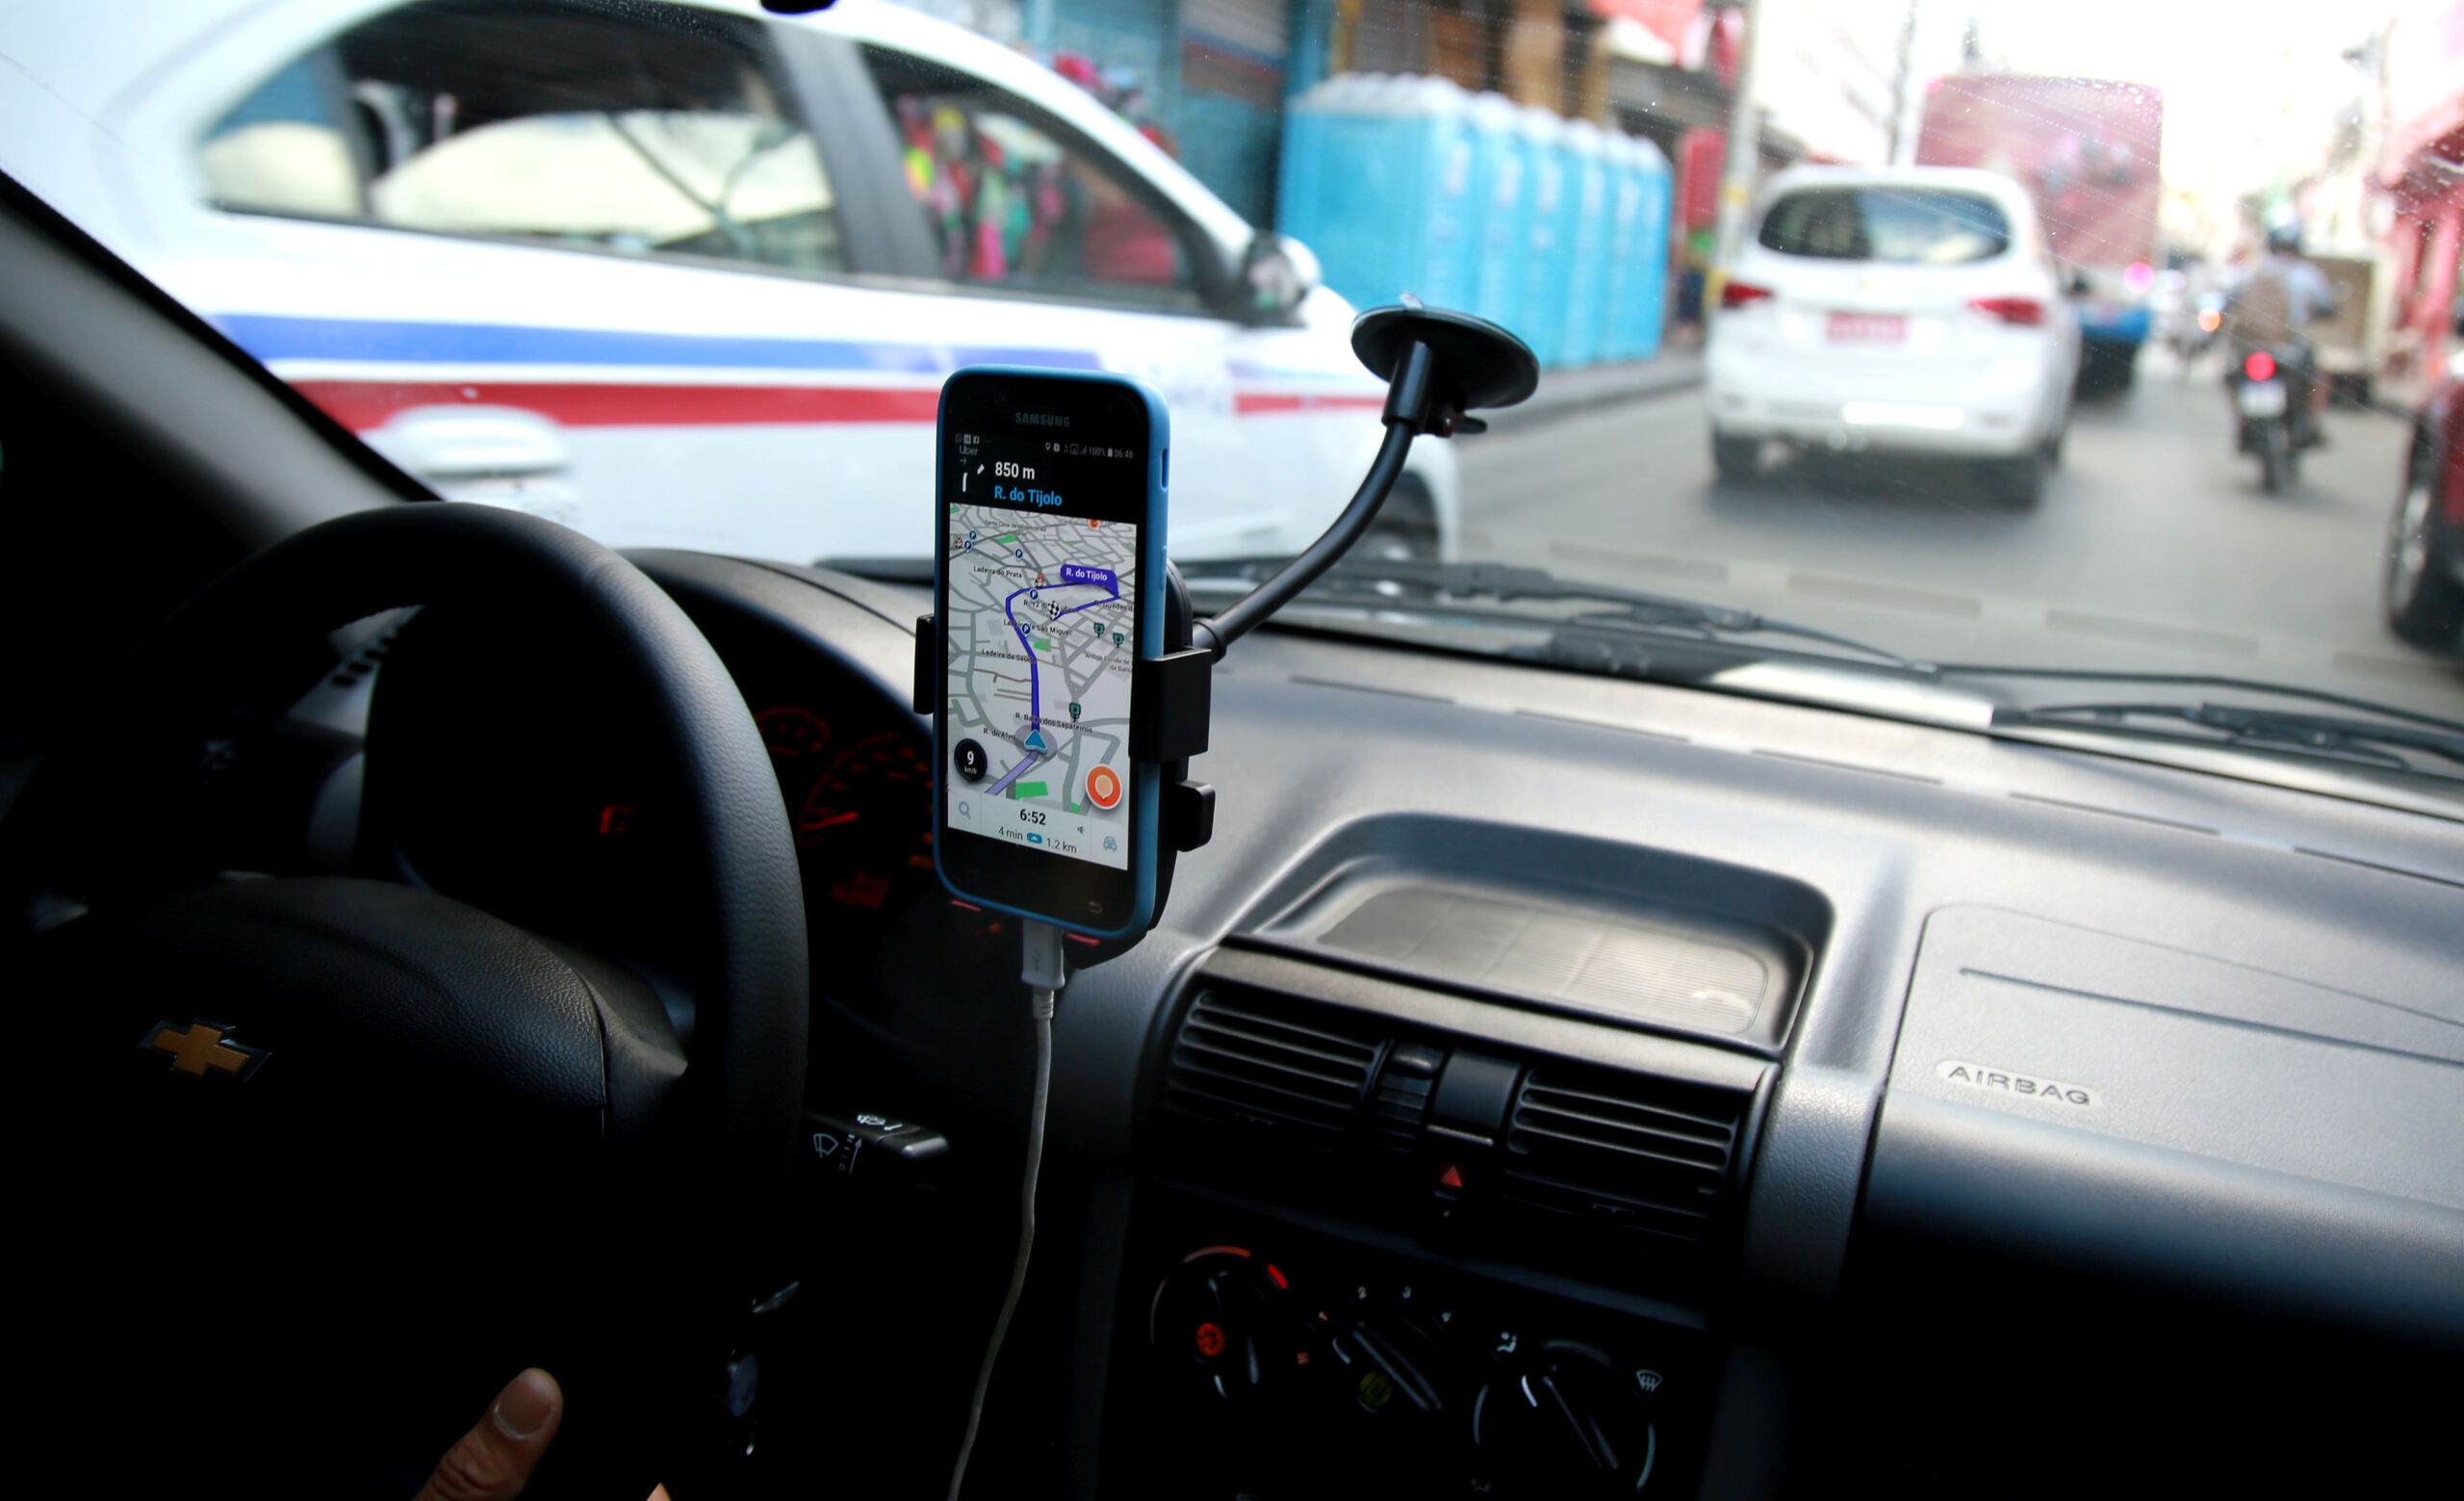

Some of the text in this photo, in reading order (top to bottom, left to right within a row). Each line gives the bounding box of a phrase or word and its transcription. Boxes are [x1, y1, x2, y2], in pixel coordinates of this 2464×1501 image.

[1015, 412, 1070, 427] SAMSUNG
[959, 445, 978, 455] Uber
[1089, 447, 1106, 456] 100%
[995, 461, 1036, 479] 850 m
[994, 485, 1063, 507] R. do Tijolo
[1006, 570, 1022, 579] Prata
[1065, 568, 1108, 582] R. do Tijolo
[982, 649, 1005, 659] Ladeira
[967, 750, 974, 765] 9
[1019, 809, 1046, 825] 6:52
[998, 826, 1023, 841] 4 min
[1046, 838, 1077, 854] 1.2 km
[1948, 1066, 2091, 1106] AIRBAG
